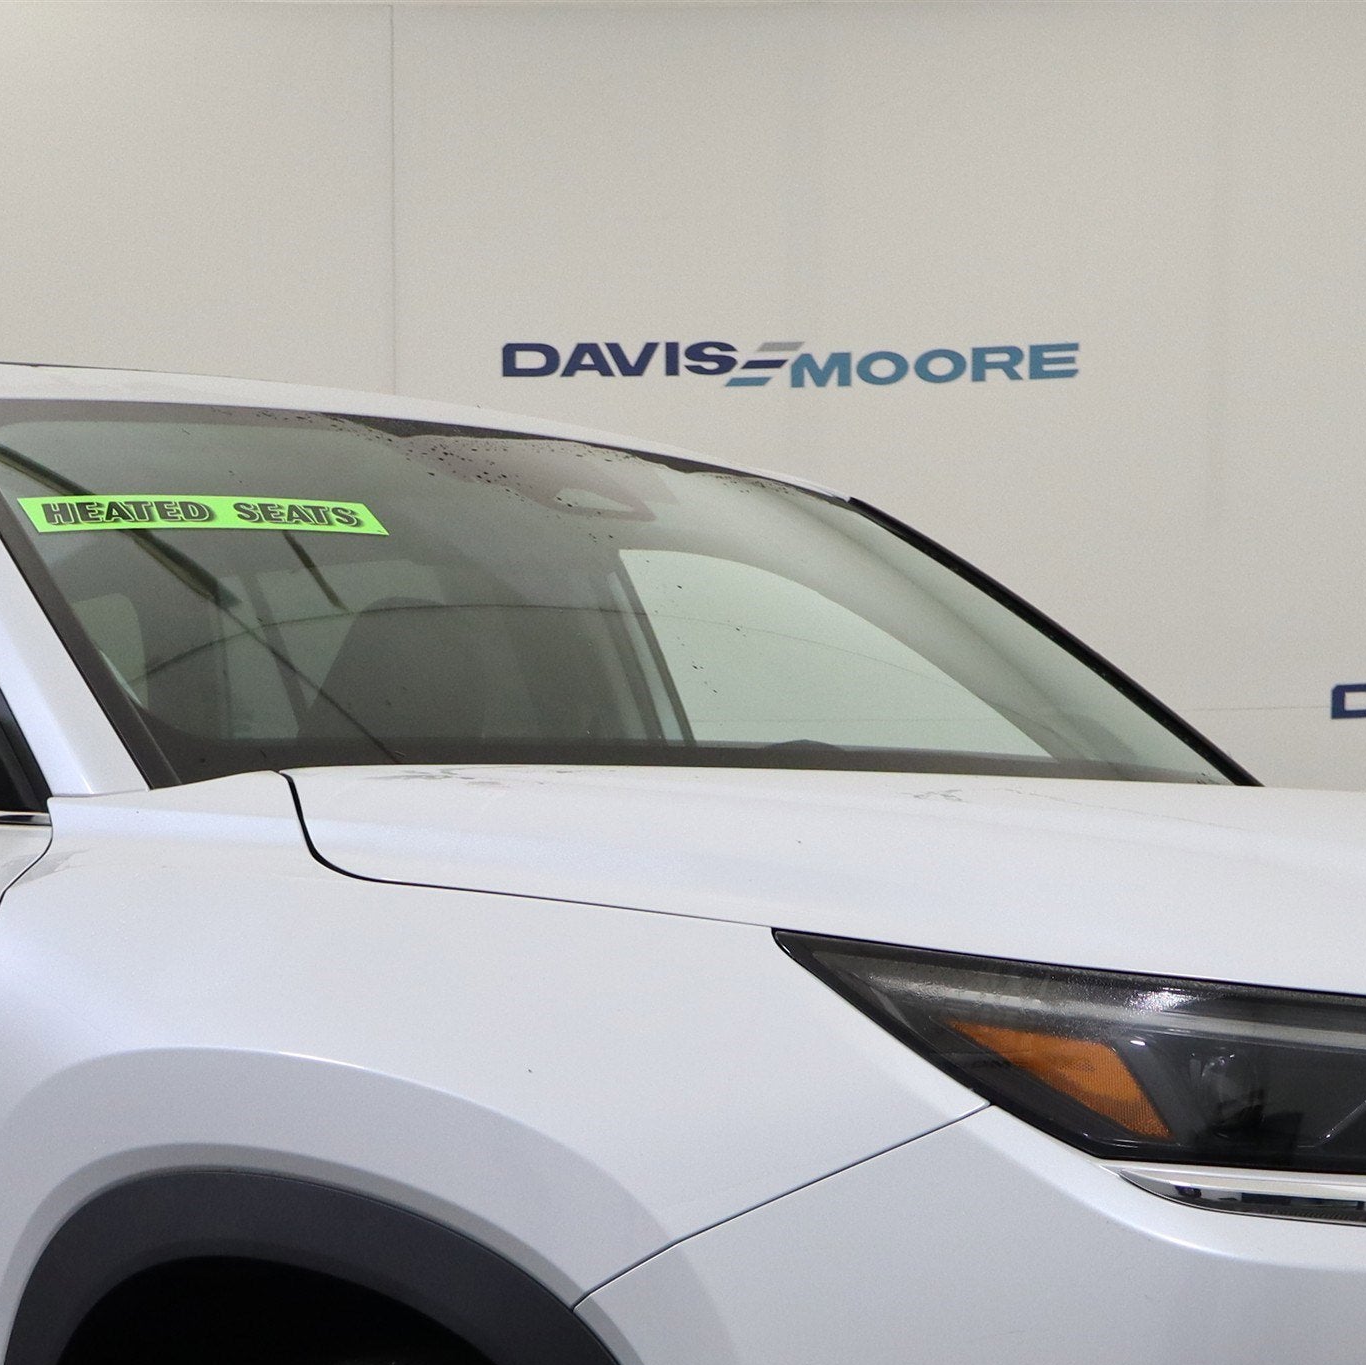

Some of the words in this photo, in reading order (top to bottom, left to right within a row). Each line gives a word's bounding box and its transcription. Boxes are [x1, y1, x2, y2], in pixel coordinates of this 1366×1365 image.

[502, 341, 739, 378] DAVIS
[790, 343, 1080, 388] MOORE
[41, 500, 213, 525] HEATED
[233, 503, 365, 527] SEATS
